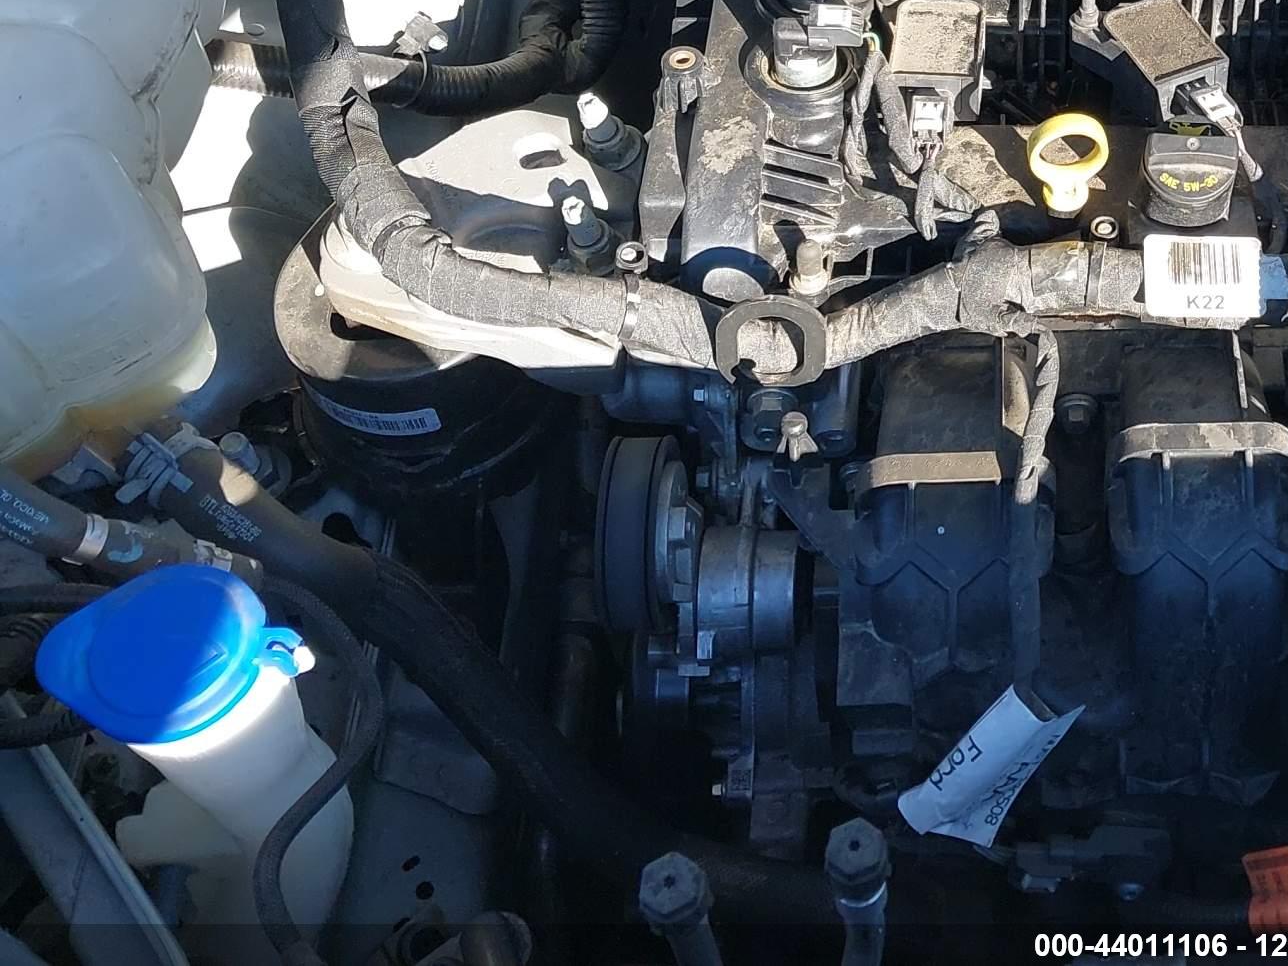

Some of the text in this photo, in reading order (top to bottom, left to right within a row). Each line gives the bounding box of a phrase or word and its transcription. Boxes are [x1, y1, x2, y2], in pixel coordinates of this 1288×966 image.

[1158, 171, 1219, 193] SAE 5W-30
[1186, 294, 1226, 311] K22
[928, 734, 983, 792] Ford
